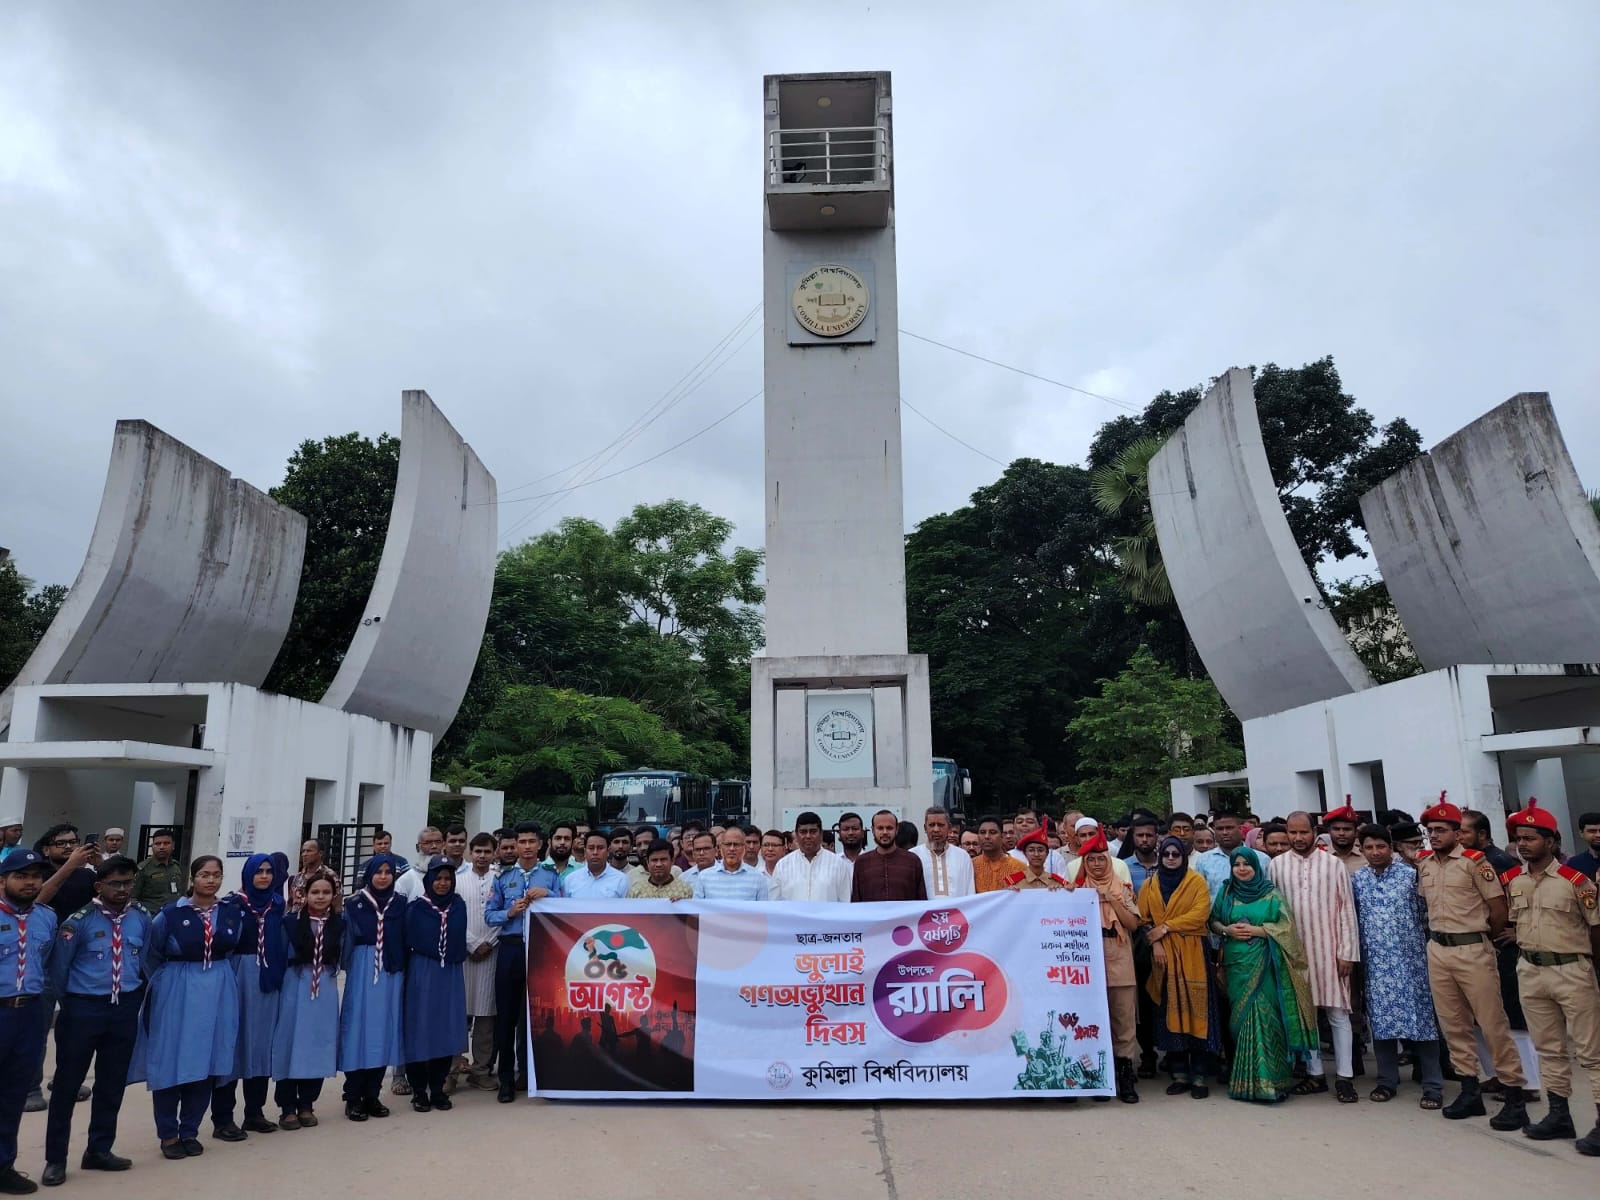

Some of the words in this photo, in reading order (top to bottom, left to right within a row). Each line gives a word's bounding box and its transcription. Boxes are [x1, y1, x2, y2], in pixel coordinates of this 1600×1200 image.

[797, 305, 824, 332] COMILLA
[827, 304, 864, 332] UNIVERSITY
[796, 932, 863, 945] ছাত্র-জনতার
[922, 925, 962, 946] বর্ষপূর্তি
[583, 960, 629, 980] ০৫
[795, 947, 864, 983] জুলাই
[897, 964, 936, 976] উপলক্ষে
[569, 974, 652, 1011] আগস্ট
[805, 1014, 865, 1045] দিবস
[800, 1061, 858, 1088] কুমিল্লা
[863, 1060, 970, 1083] বিশ্ববিদ্যালয়
